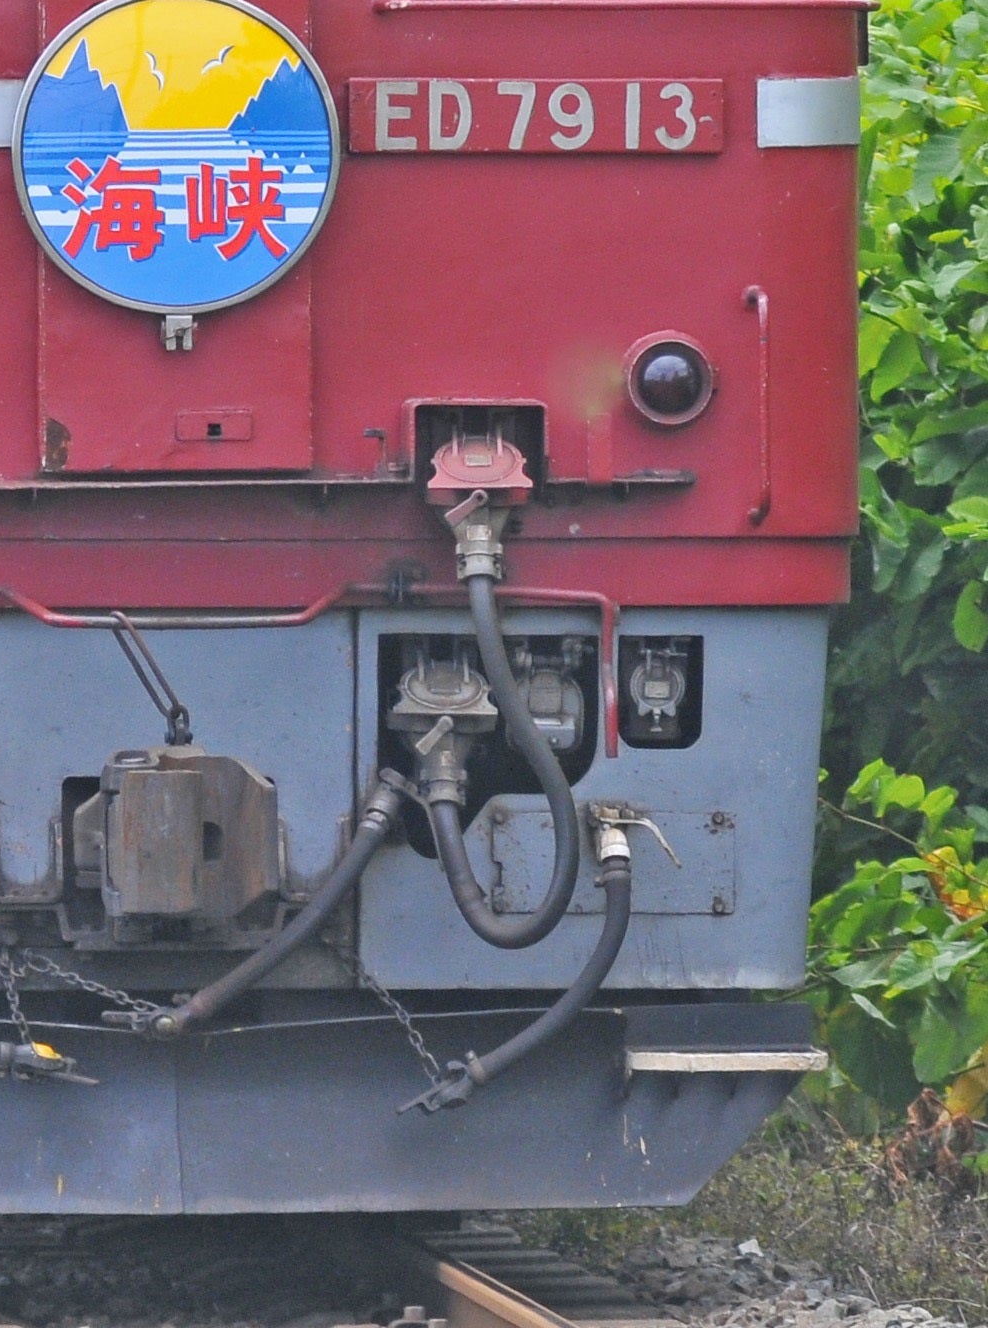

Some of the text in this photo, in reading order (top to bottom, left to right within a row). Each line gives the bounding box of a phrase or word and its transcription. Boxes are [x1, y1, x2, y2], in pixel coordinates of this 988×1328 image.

[375, 80, 697, 151] ED 79 13
[61, 154, 289, 262] 海峡
